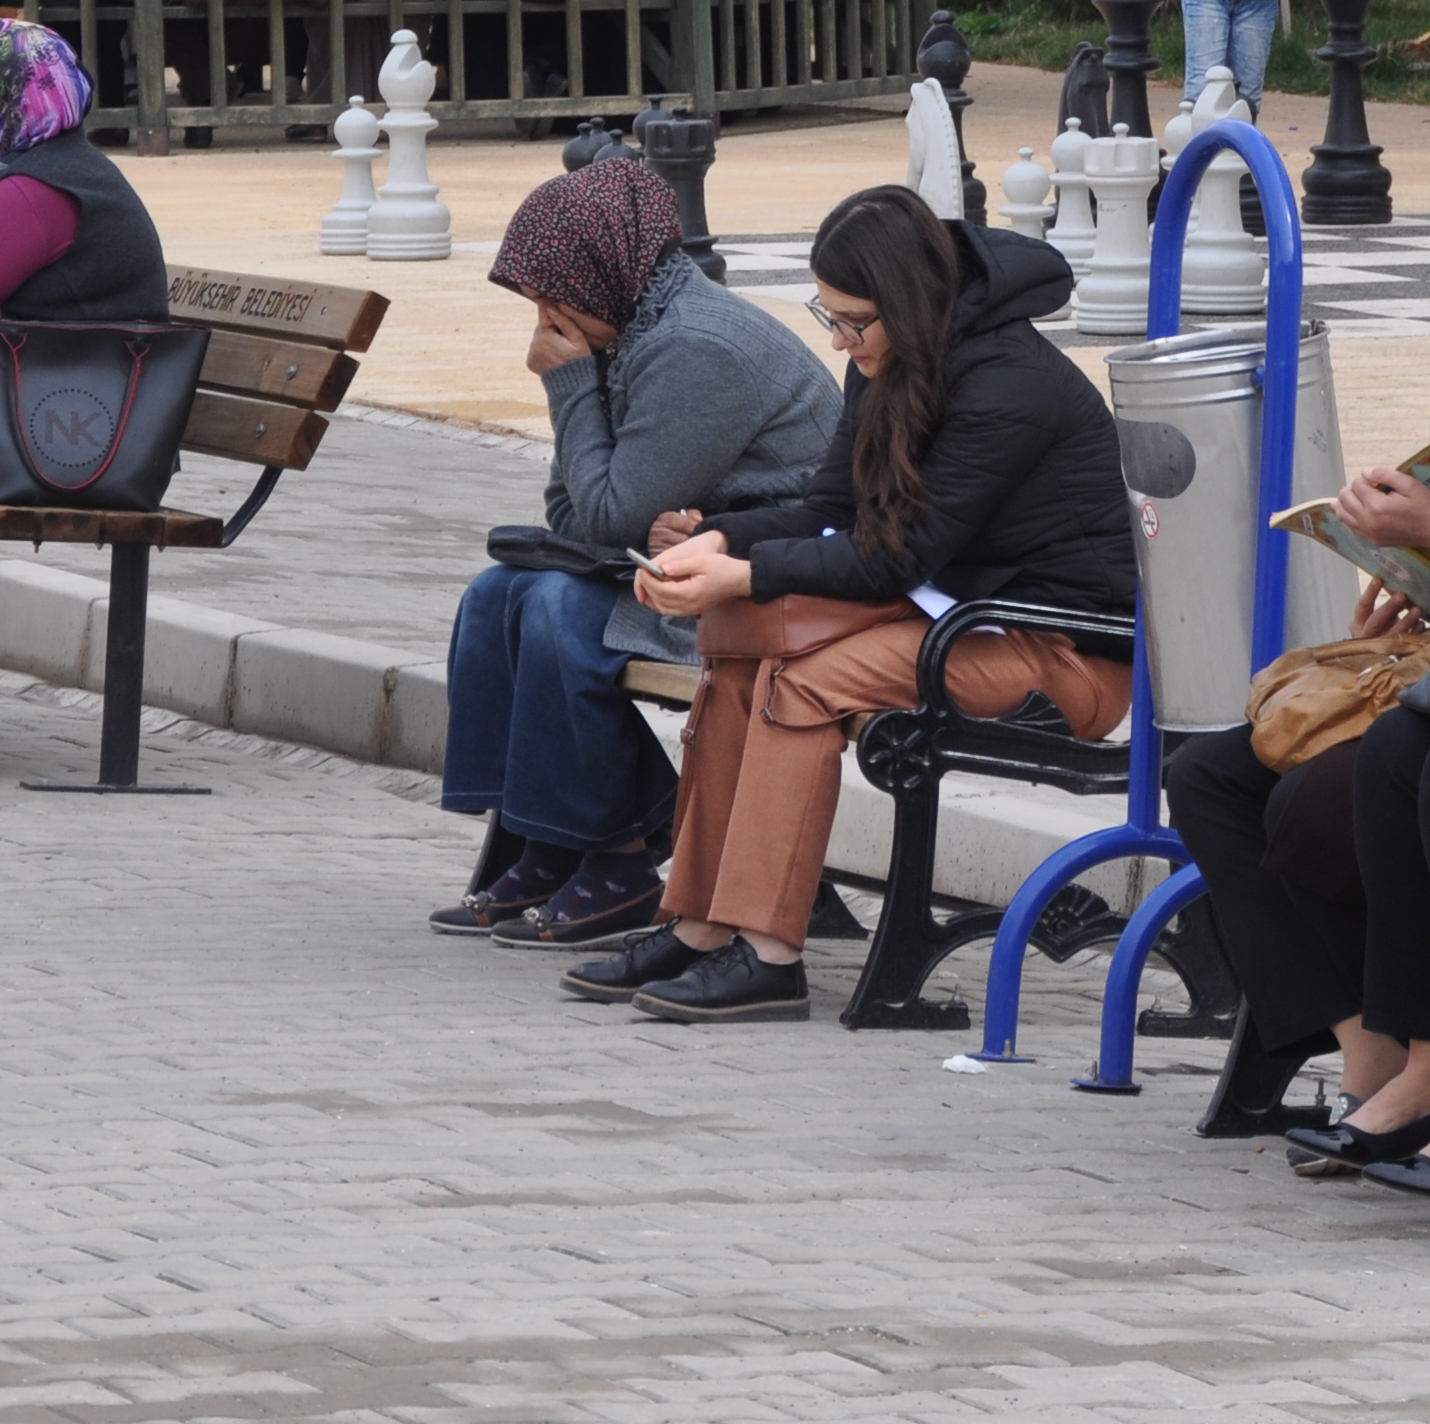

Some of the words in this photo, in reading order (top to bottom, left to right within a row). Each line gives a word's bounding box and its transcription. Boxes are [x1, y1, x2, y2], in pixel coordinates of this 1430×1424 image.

[167, 271, 241, 312] BÜYÜKŞEHİR
[240, 285, 318, 323] BELEDİYESİ
[44, 409, 102, 447] NK
